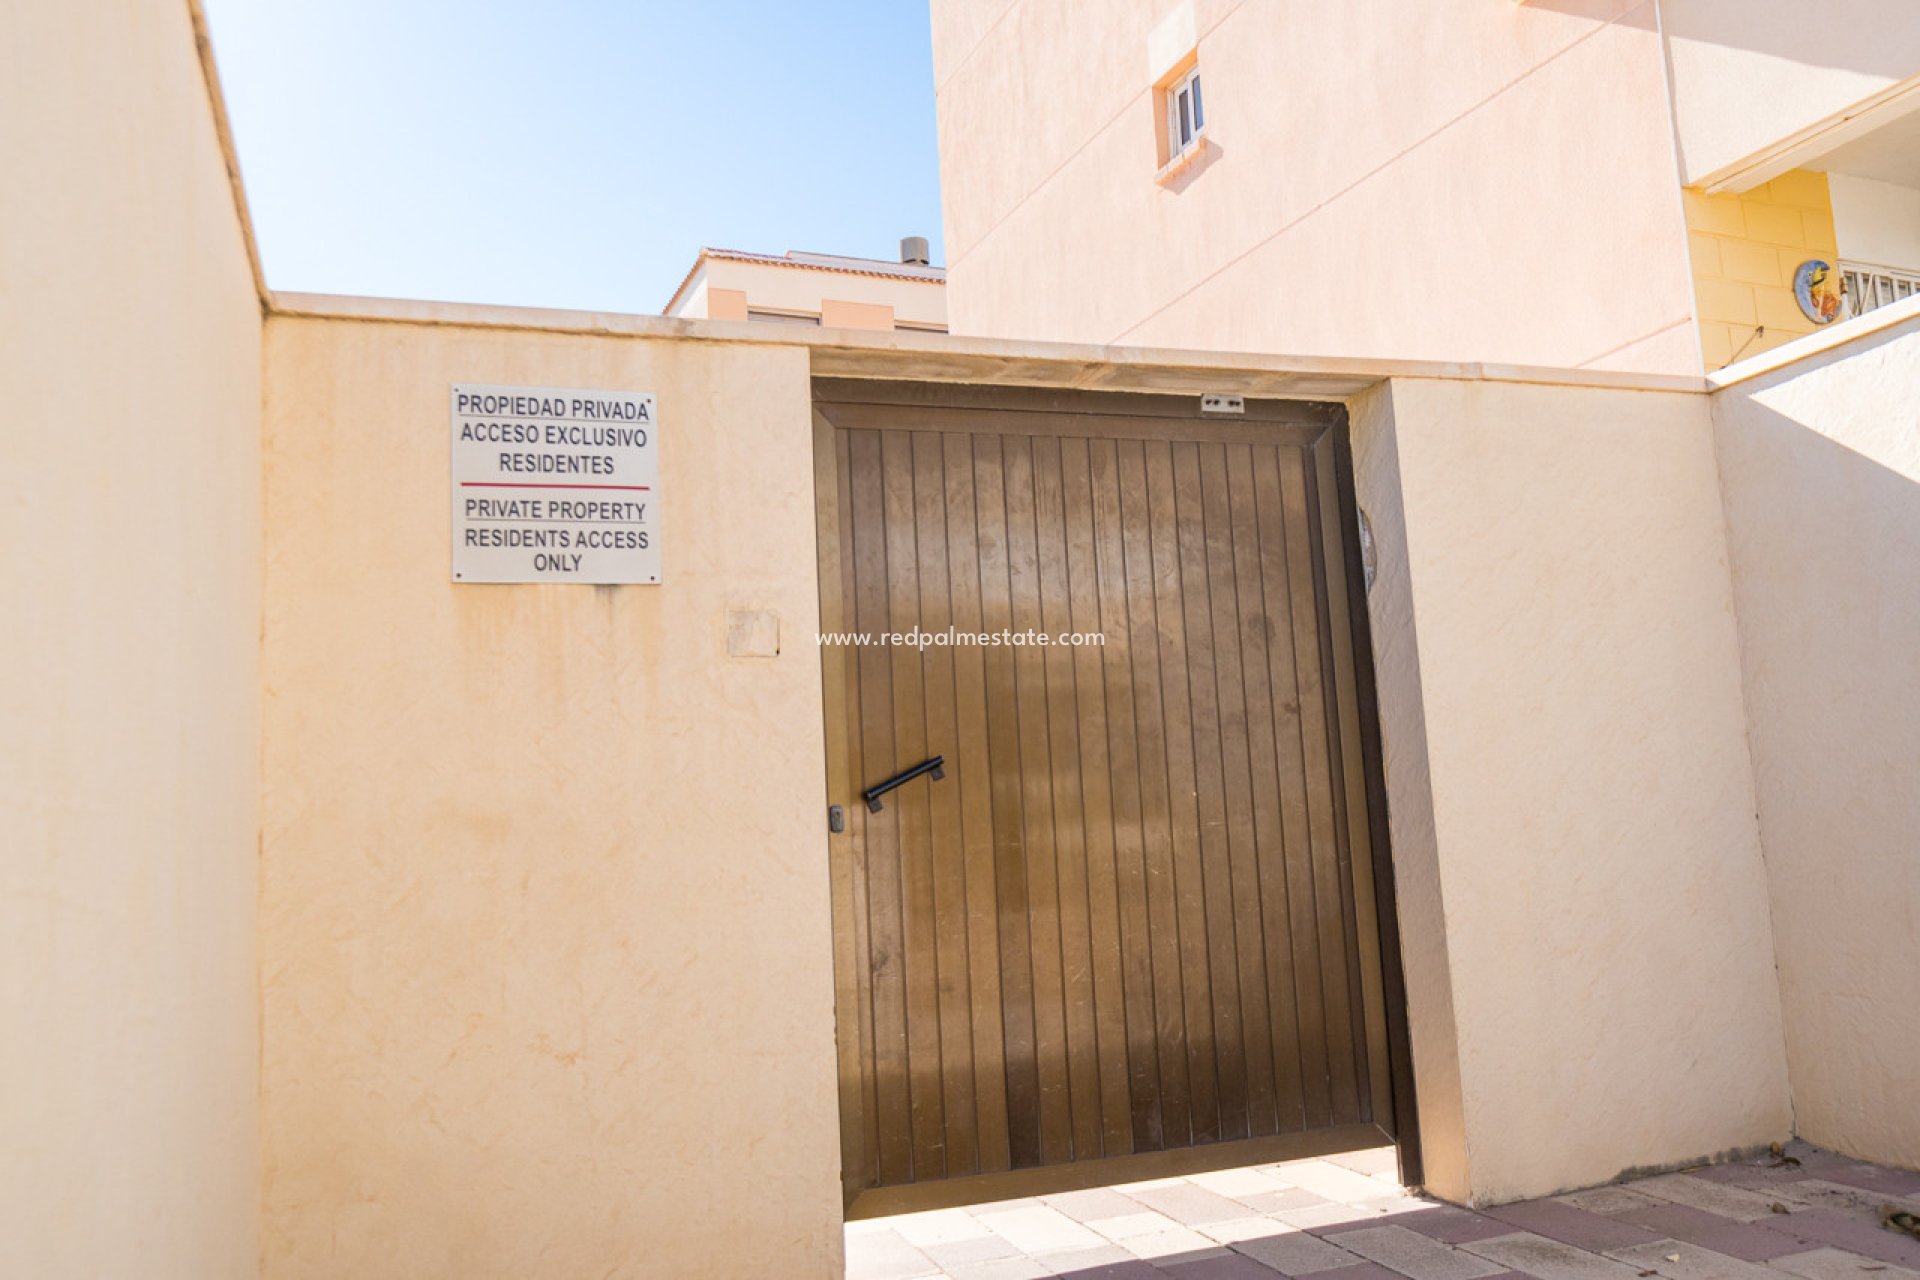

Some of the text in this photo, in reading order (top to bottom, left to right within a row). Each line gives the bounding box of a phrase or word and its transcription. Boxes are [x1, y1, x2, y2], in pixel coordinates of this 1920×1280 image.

[458, 394, 649, 420] PROPIEDAD PRIVADA
[461, 423, 647, 447] ACCESO EXCLUSIVO
[500, 453, 614, 474] RESIDENTES
[465, 499, 645, 520] PRIVATE PROPERTY
[465, 529, 649, 549] RESIDENTS ACCESS
[534, 554, 582, 571] ONLY
